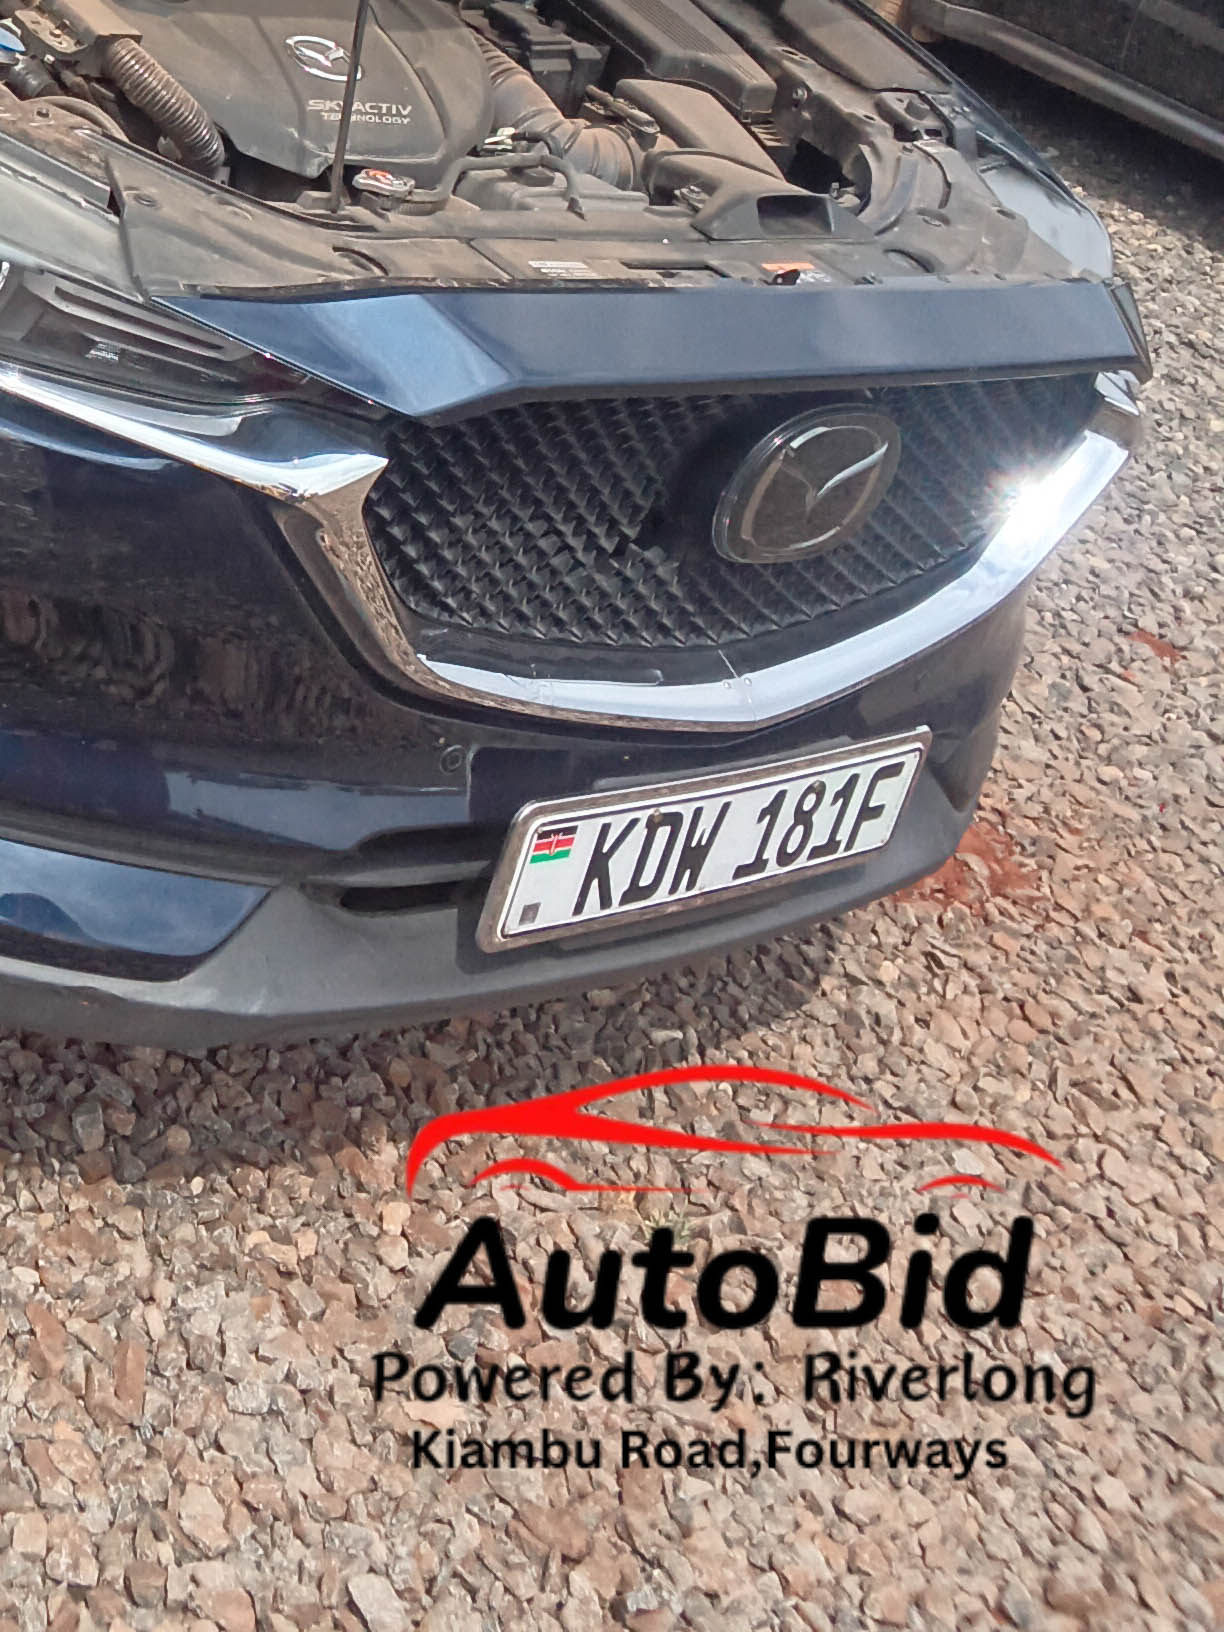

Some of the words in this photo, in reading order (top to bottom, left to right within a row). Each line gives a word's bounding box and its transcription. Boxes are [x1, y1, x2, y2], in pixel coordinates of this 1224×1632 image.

[306, 99, 413, 116] SKACTIV
[572, 801, 732, 917] KDW
[732, 760, 905, 881] 181F
